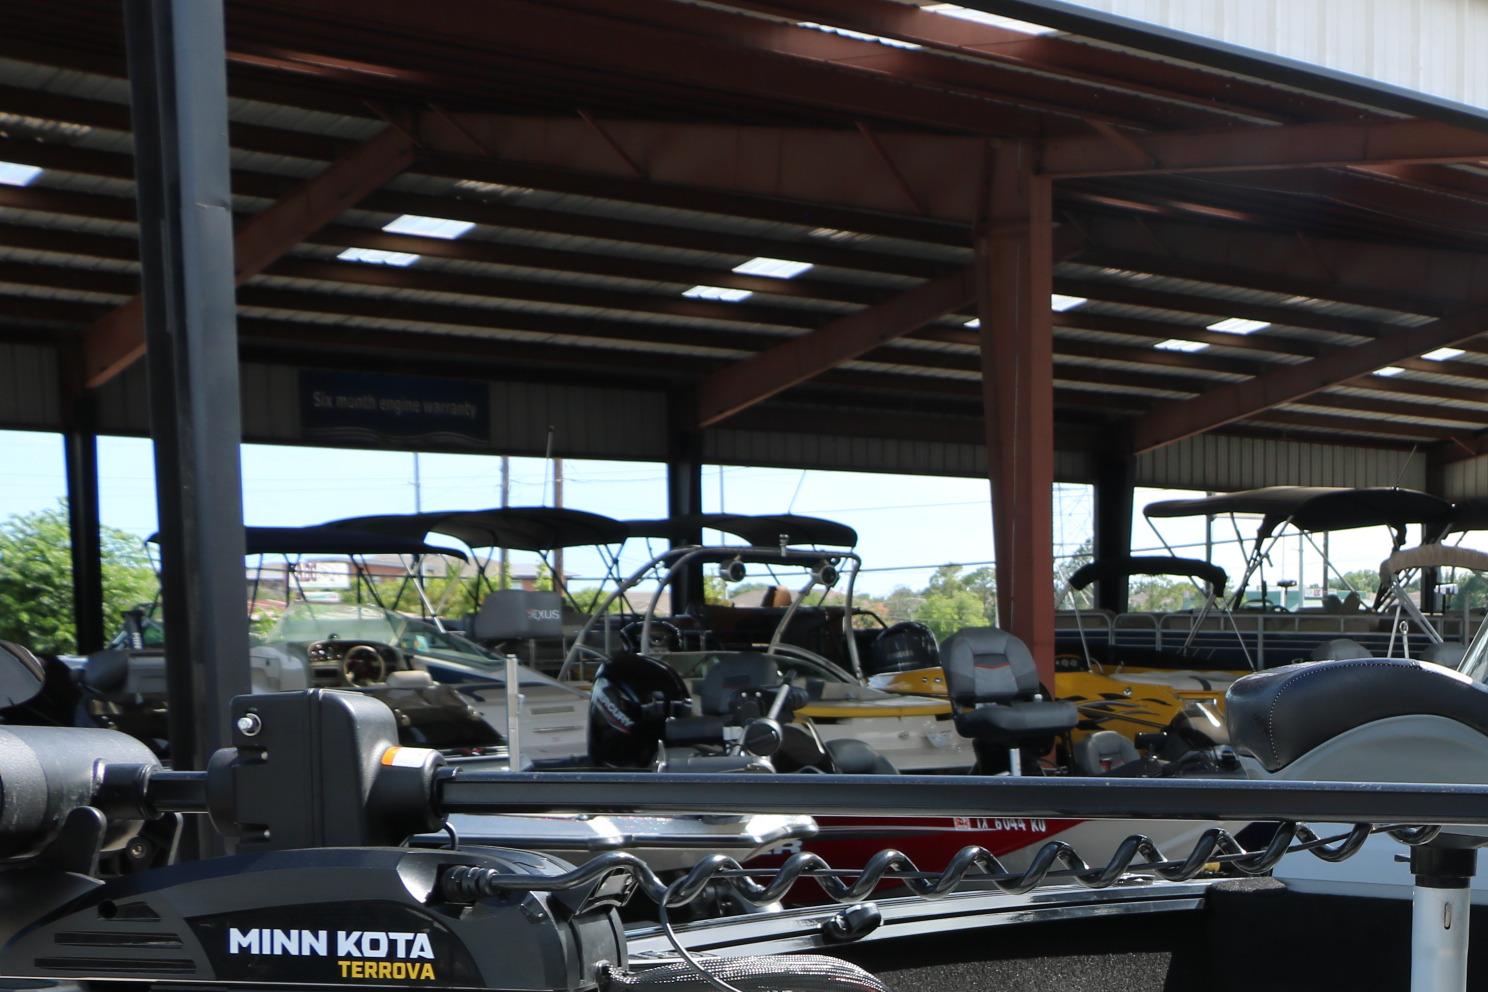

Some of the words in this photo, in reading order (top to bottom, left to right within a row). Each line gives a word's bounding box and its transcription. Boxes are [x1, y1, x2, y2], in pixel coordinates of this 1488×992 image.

[312, 391, 333, 408] Six
[336, 394, 377, 410] month
[379, 397, 421, 415] engine
[423, 400, 477, 419] warranty
[229, 927, 328, 957] MINN
[336, 930, 435, 959] KOTA
[337, 960, 436, 980] TERROVA
